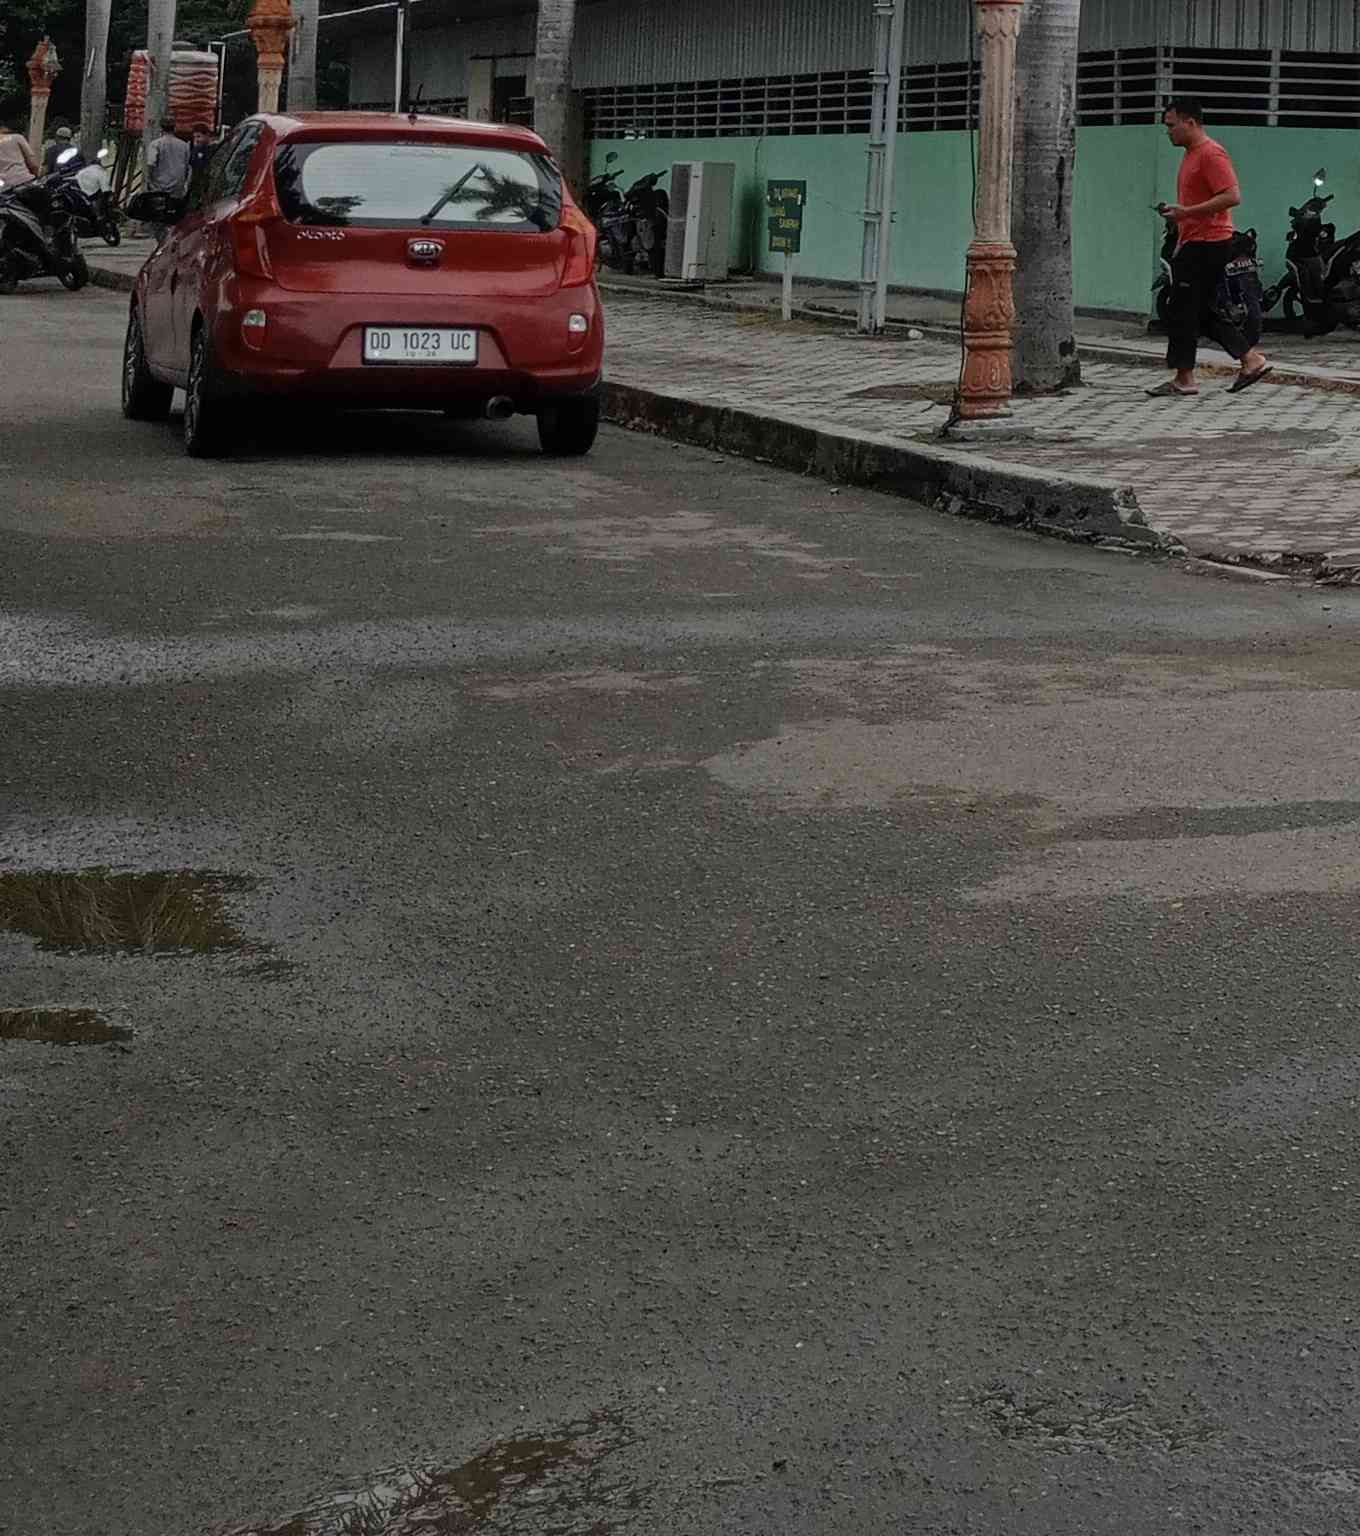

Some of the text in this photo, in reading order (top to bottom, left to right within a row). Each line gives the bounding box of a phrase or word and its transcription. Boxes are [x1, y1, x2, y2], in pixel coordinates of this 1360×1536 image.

[370, 332, 471, 350] DD 1023 UC
